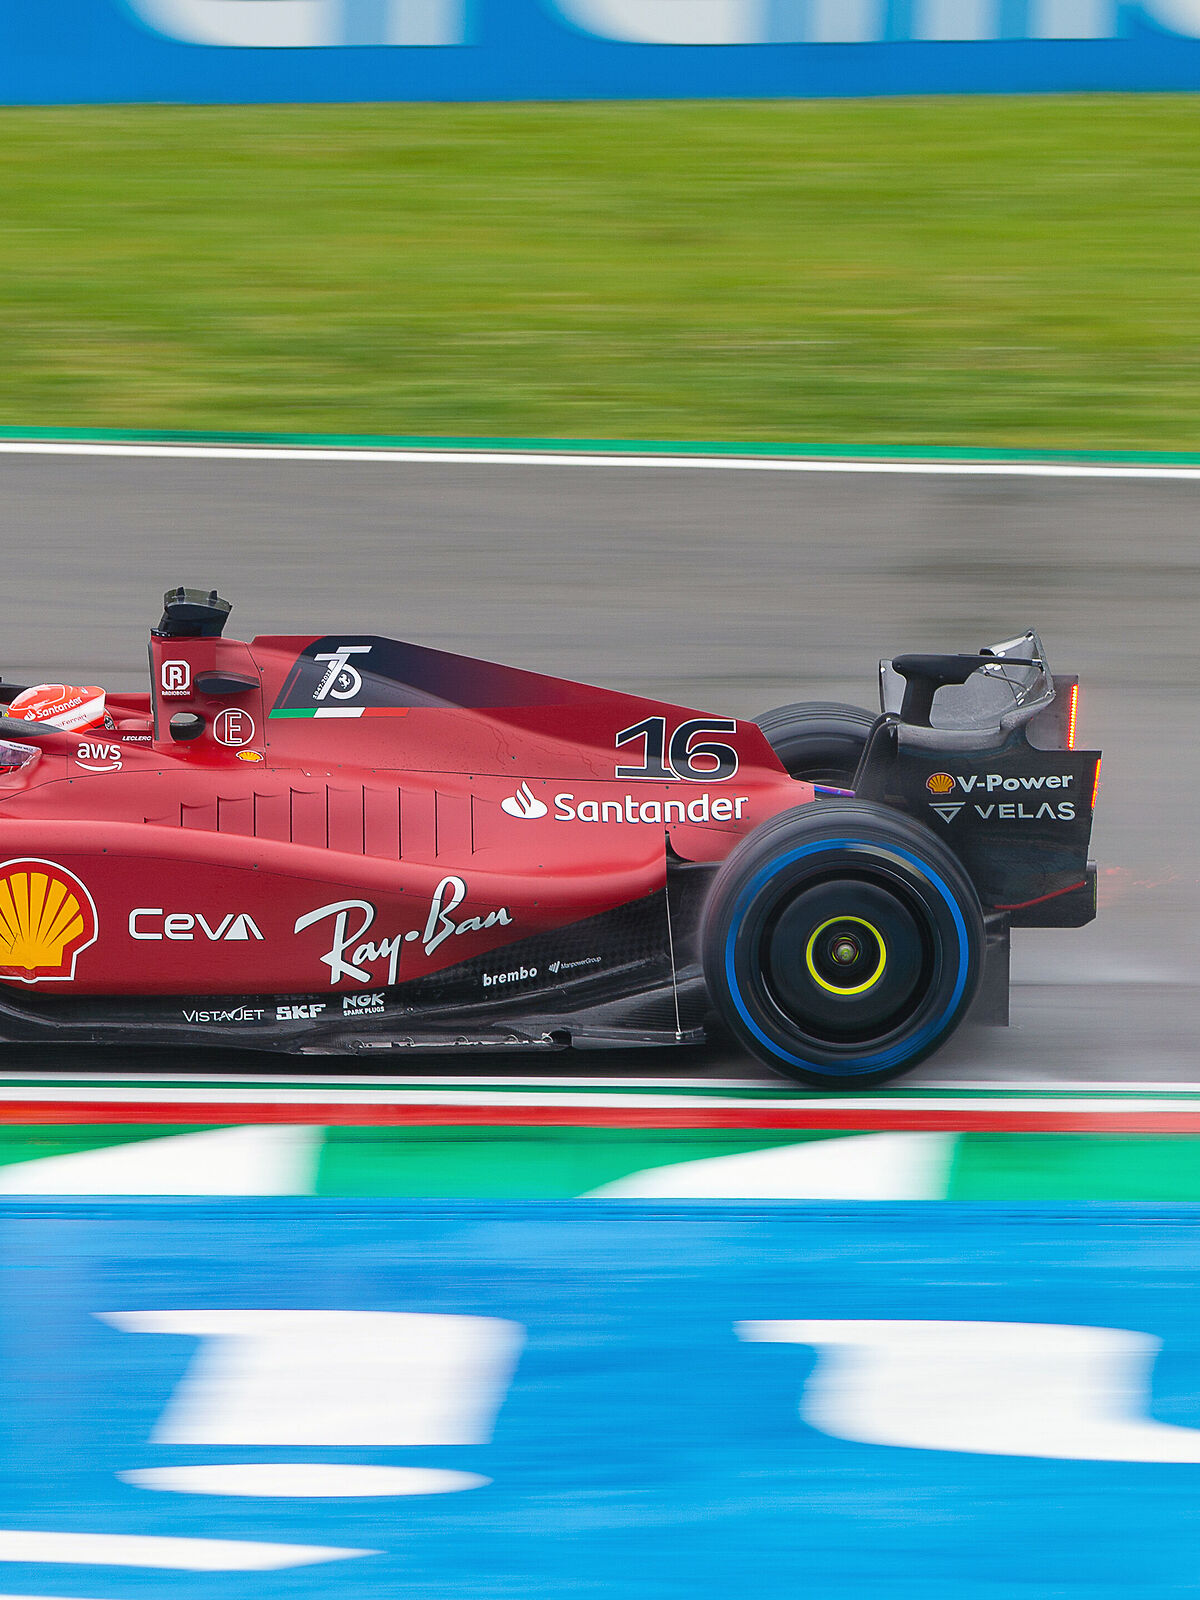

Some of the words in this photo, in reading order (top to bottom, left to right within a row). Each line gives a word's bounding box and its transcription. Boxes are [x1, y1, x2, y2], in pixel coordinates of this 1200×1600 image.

[36, 696, 83, 719] Santander
[77, 742, 121, 760] aws
[615, 716, 739, 783] 16
[957, 773, 1074, 793] V-Power
[553, 793, 749, 824] Santander
[974, 801, 1077, 821] VELAS
[483, 966, 539, 987] brembo
[342, 992, 386, 1010] NGK
[343, 1008, 362, 1017] SPARK
[364, 1005, 386, 1015] PLUGS
[275, 1003, 327, 1021] SKF
